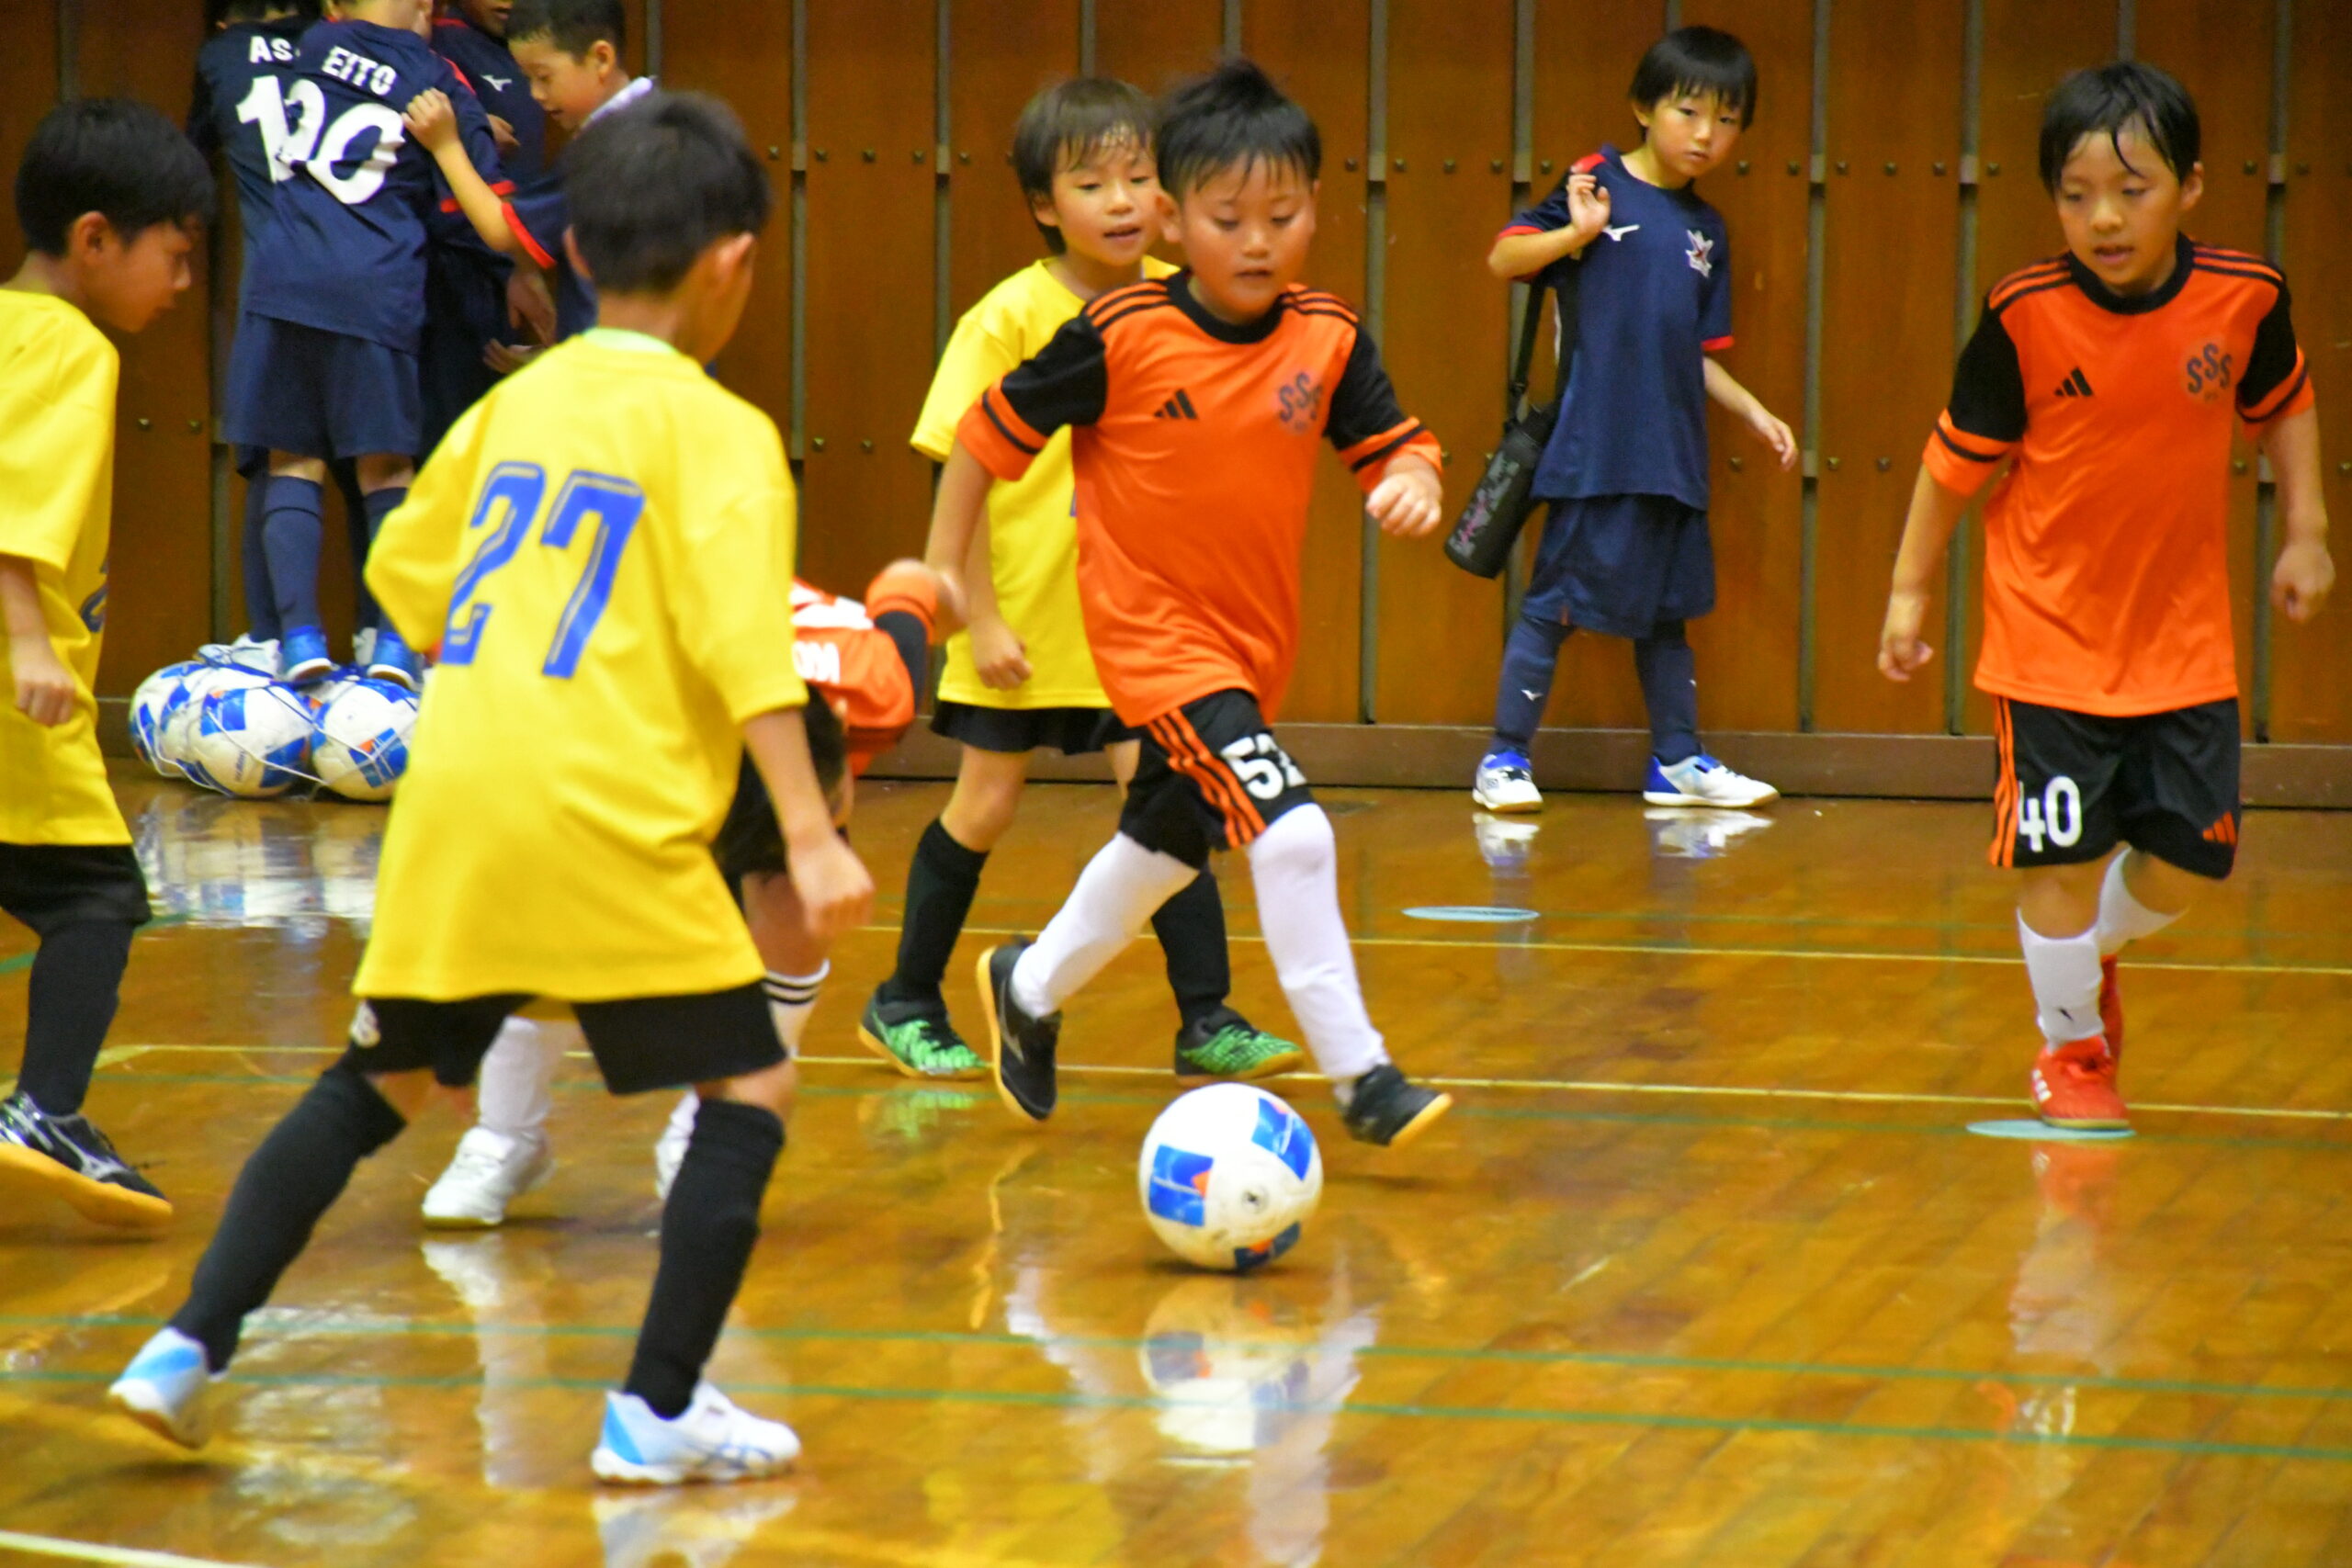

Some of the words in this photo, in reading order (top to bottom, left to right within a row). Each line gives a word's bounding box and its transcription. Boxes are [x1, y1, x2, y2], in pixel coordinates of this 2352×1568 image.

[321, 45, 398, 96] EITO
[439, 460, 646, 680] 27
[2018, 775, 2082, 852] 40
